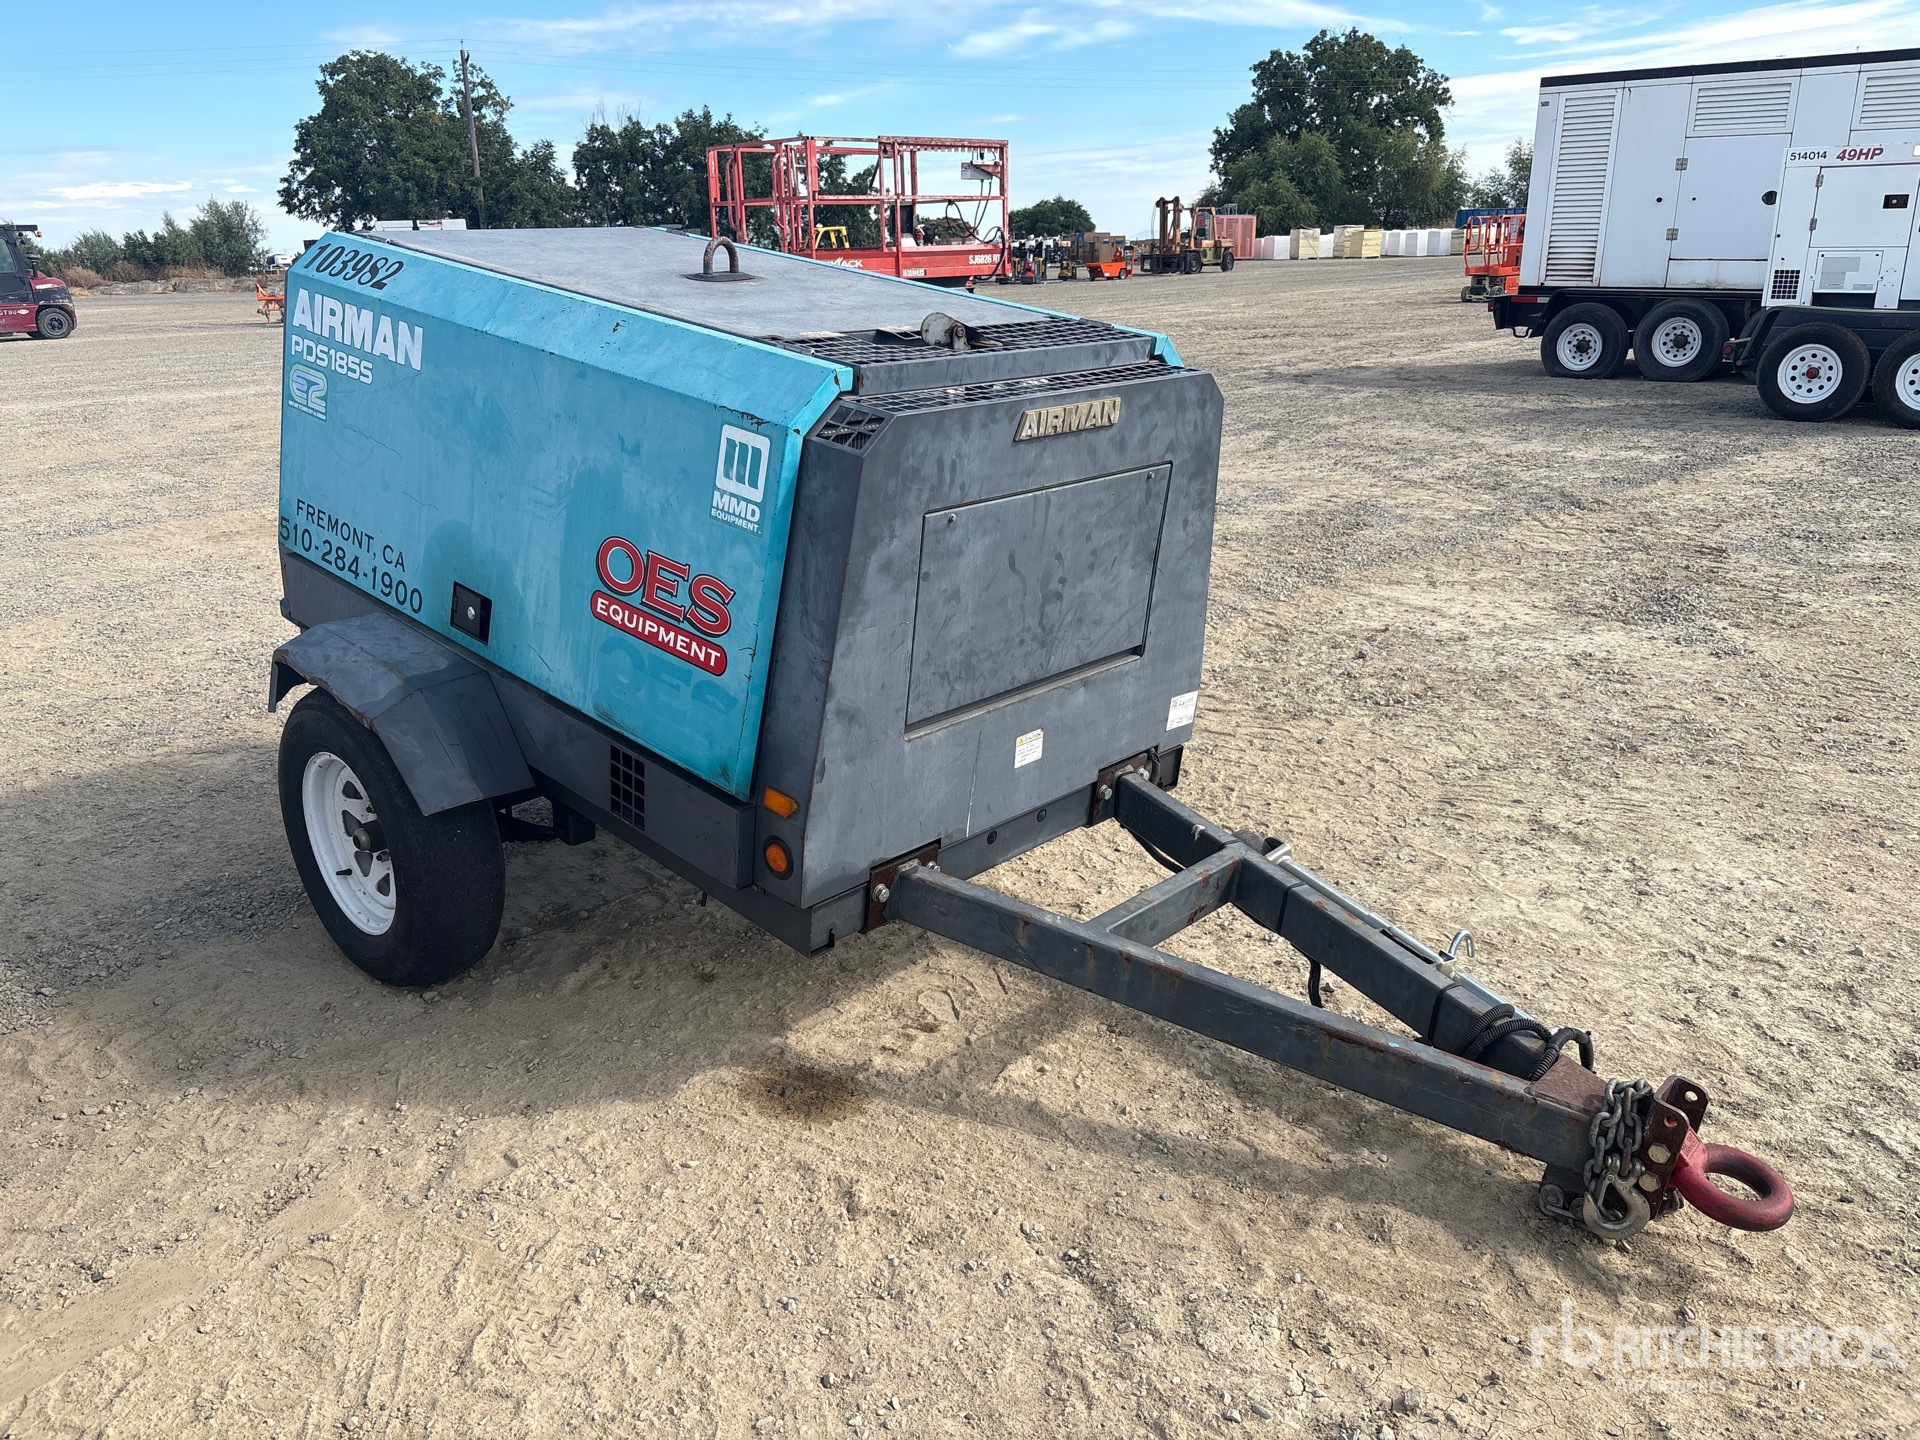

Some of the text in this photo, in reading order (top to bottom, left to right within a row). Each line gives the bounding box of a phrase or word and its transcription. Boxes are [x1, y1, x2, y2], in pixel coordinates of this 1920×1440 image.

[1790, 151, 1827, 161] 514014
[1836, 147, 1884, 161] 49HP
[303, 243, 404, 290] 103982
[292, 288, 424, 372] AIRMAN
[291, 334, 373, 385] PDS185S
[1017, 399, 1121, 441] AIRMAN
[712, 490, 761, 522] MMD
[296, 498, 406, 573] FREMONT, CA
[279, 515, 423, 614] 510-284-1900
[596, 536, 736, 638] OES
[596, 596, 721, 668] EQUIPMENT
